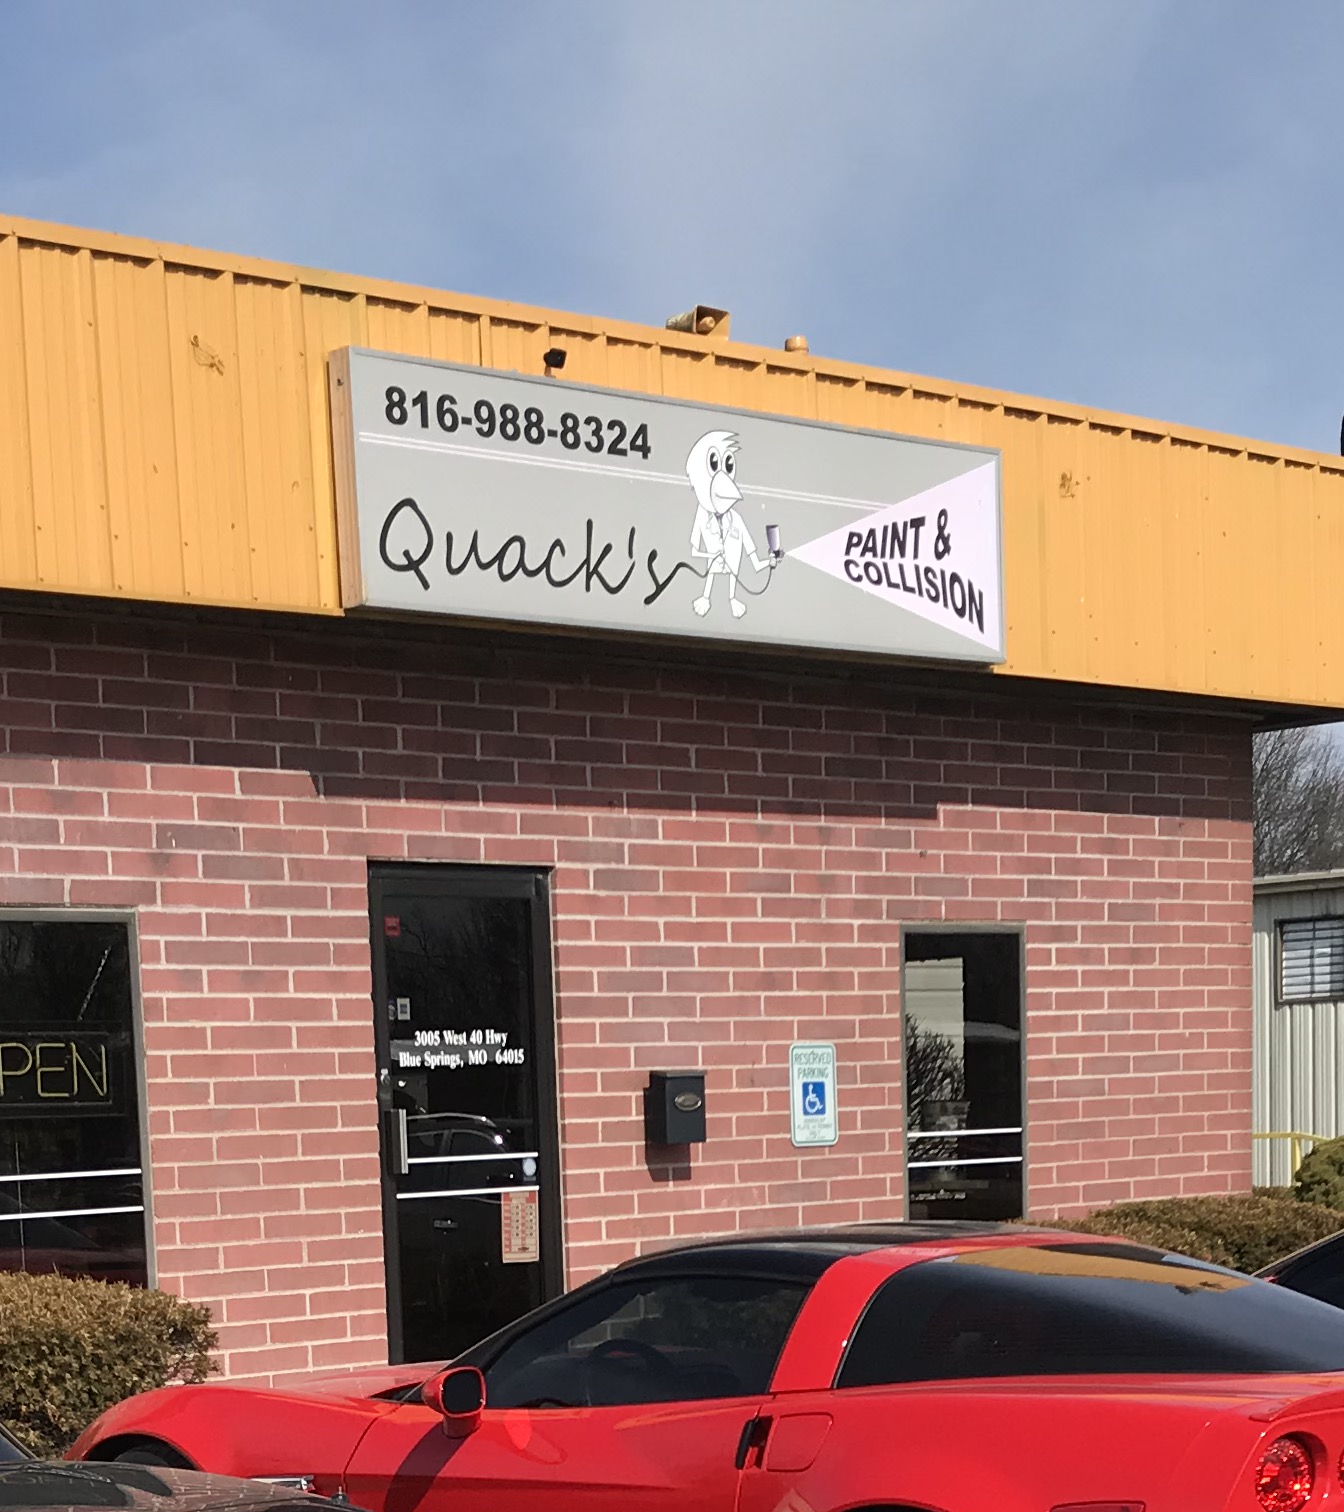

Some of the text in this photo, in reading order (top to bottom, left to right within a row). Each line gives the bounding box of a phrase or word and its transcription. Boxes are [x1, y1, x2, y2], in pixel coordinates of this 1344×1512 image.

[384, 385, 652, 460] 816-988-8324
[379, 496, 686, 605] Quack's
[844, 508, 952, 561] PAINT &
[844, 558, 985, 635] COLLISION
[414, 1028, 508, 1048] 3005 West 40 Hwy
[399, 1048, 525, 1070] Blue Springs, MO 64015
[794, 1050, 832, 1065] RESERVED
[797, 1066, 830, 1080] PARKING
